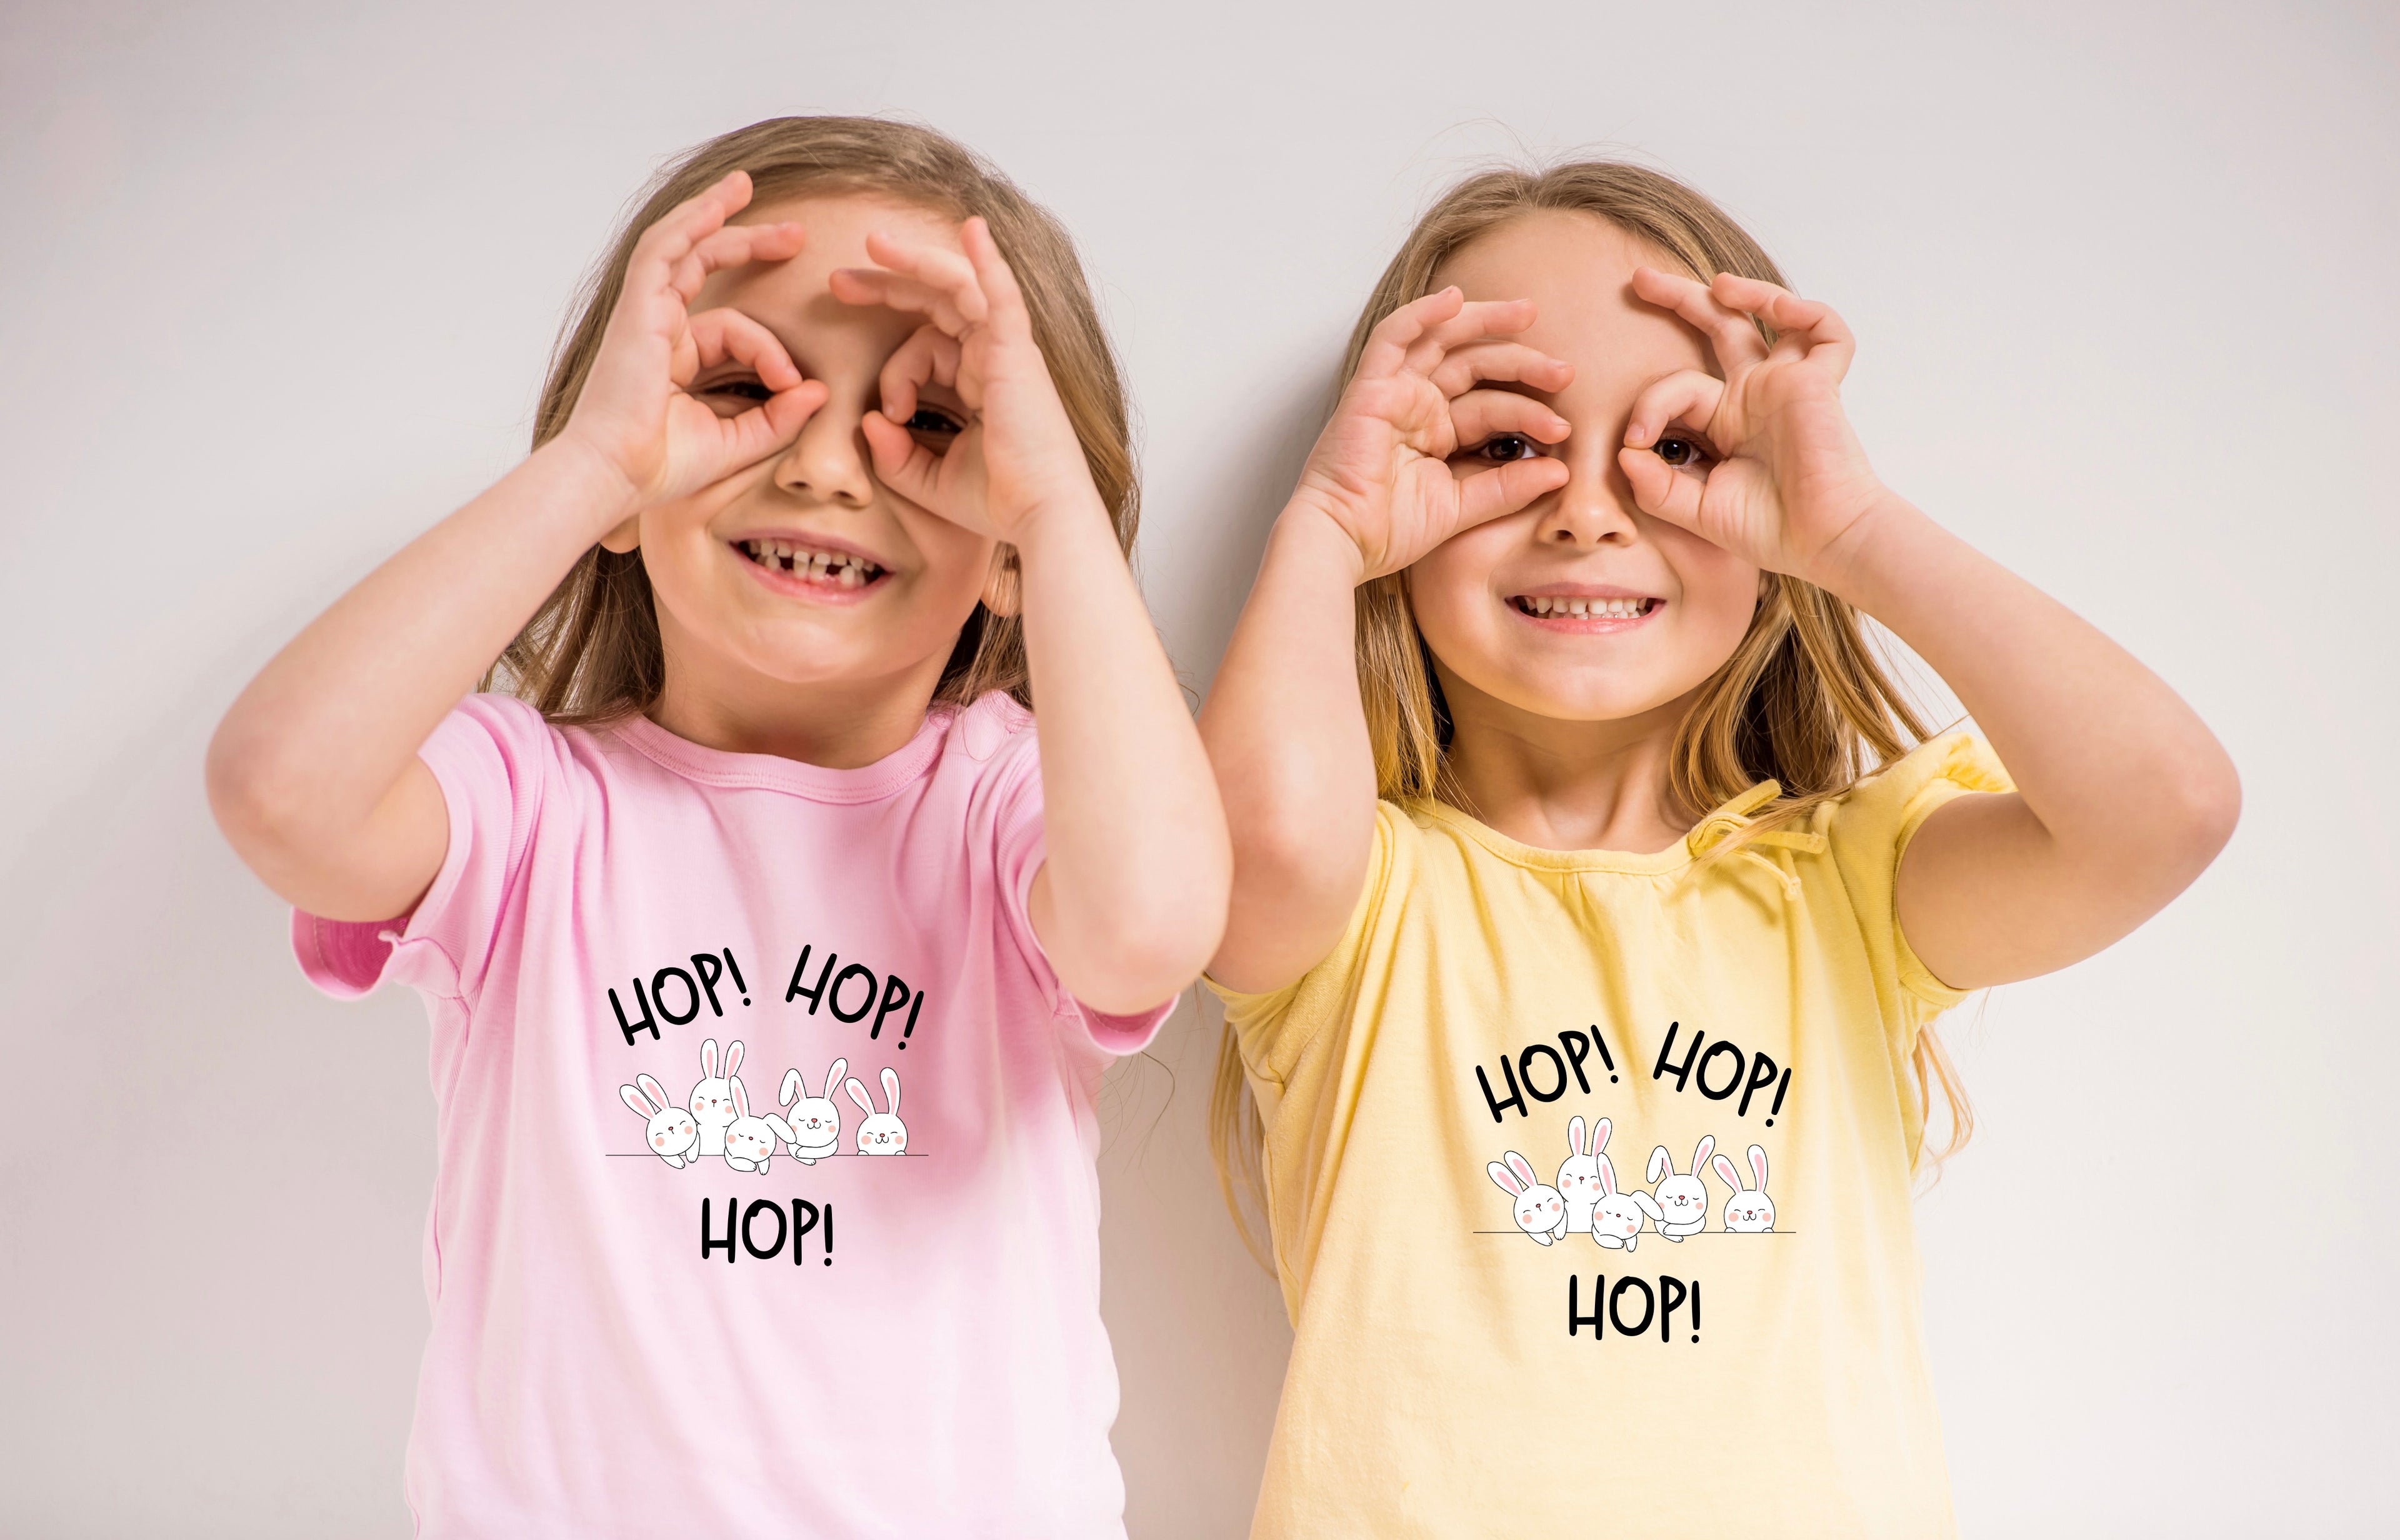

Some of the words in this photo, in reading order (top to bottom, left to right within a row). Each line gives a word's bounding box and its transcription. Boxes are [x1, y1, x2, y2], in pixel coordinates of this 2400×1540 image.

[608, 947, 751, 1046] HOP!
[785, 944, 924, 1050] HOP!
[1475, 1024, 1619, 1123] HOP!
[1652, 1021, 1792, 1128] HOP!
[701, 1197, 833, 1267] HOP!
[1569, 1274, 1701, 1344] HOP!
